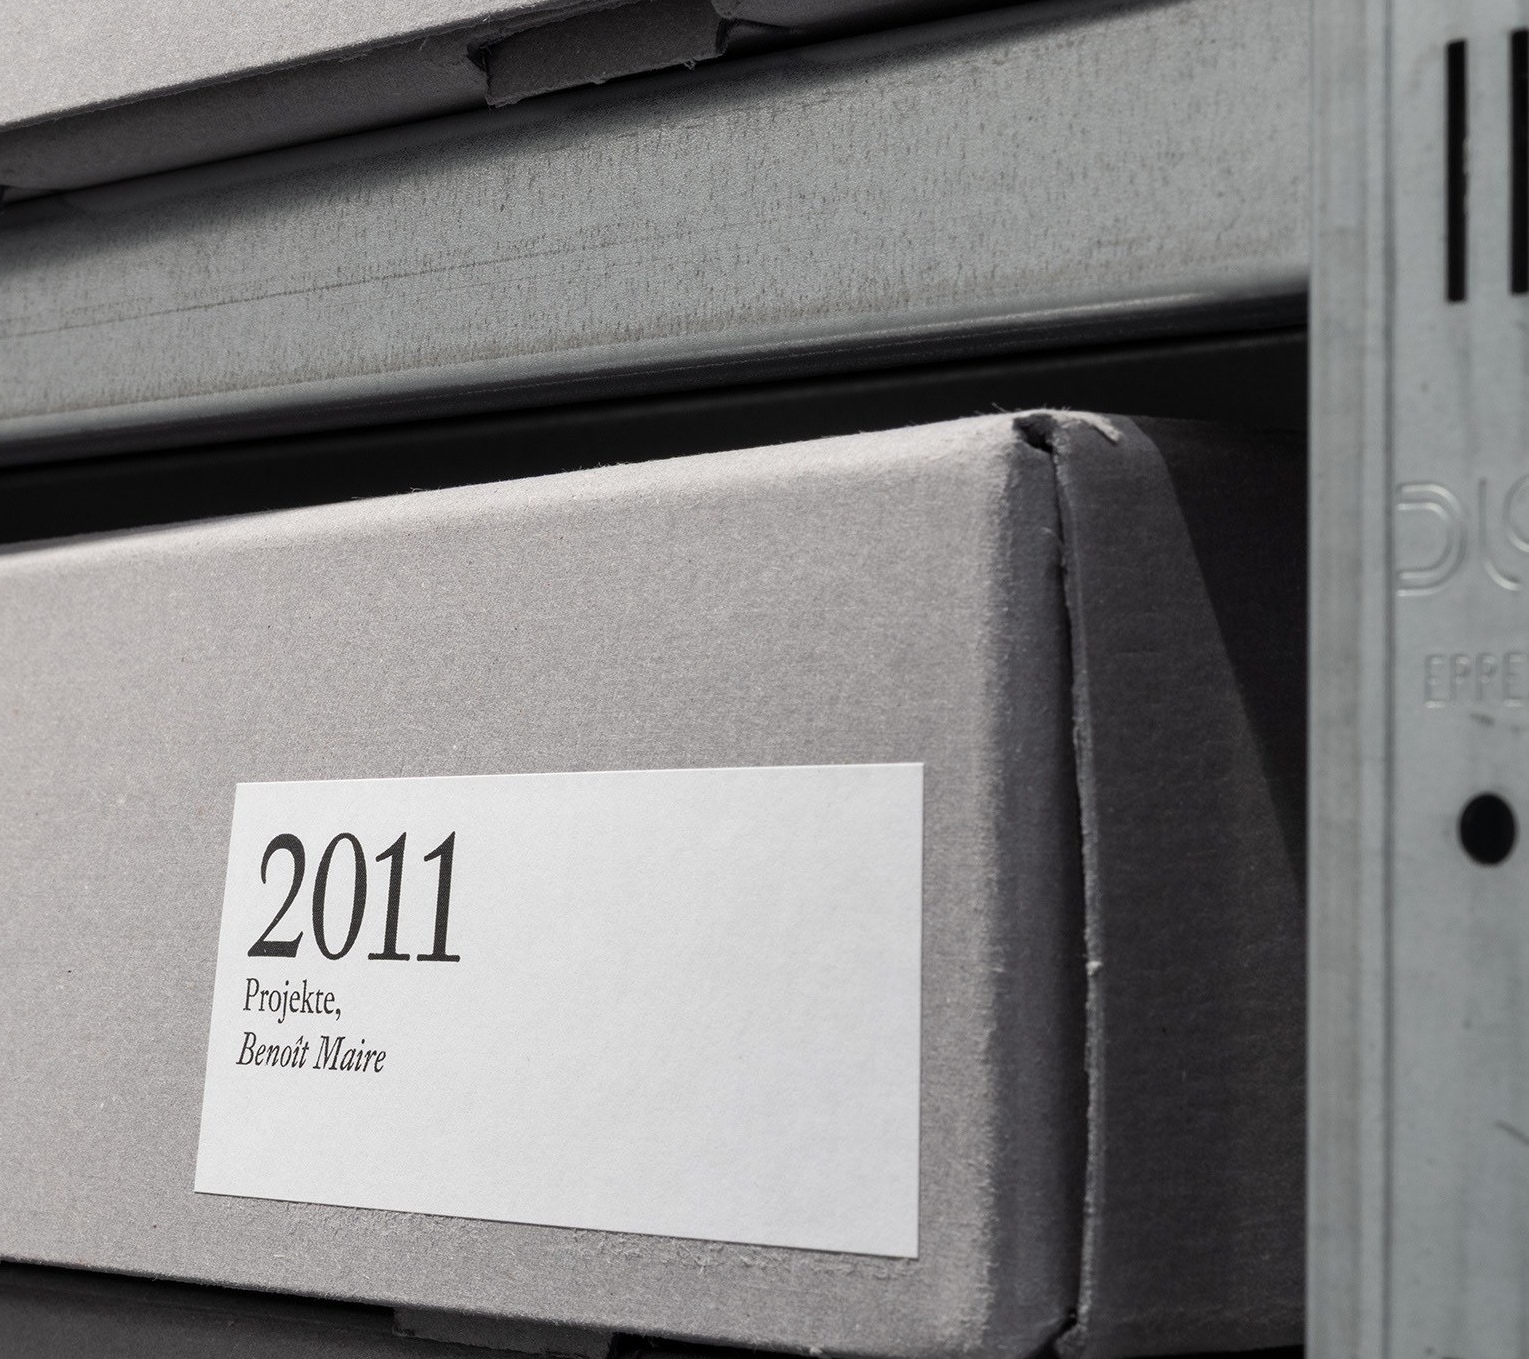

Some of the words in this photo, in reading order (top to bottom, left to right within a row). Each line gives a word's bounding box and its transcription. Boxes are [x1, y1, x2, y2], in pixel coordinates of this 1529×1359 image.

[246, 830, 461, 964] 2011
[242, 976, 342, 1024] Projekte,
[236, 1031, 310, 1071] Benoît
[312, 1033, 387, 1074] Maire
